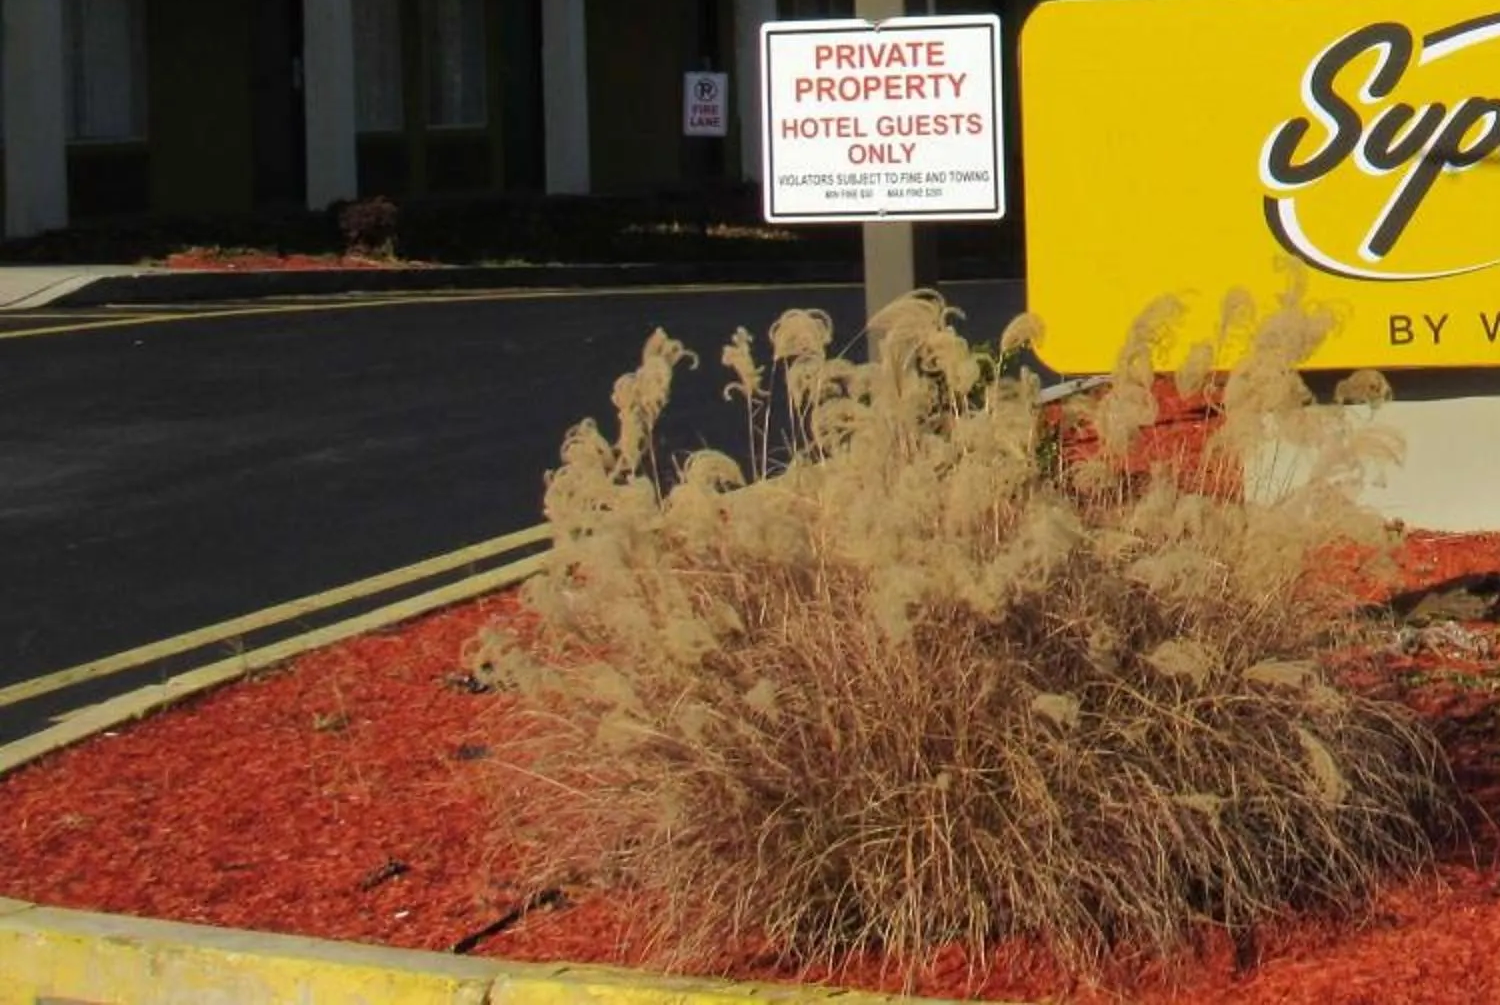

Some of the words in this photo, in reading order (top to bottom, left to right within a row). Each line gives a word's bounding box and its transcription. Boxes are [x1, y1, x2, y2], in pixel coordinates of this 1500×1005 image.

[815, 41, 945, 70] PRIVATE
[795, 72, 967, 102] PROPERTY
[690, 117, 721, 127] LANE
[781, 117, 868, 139] HOTEL
[876, 113, 983, 137] GUESTS
[847, 143, 916, 165] ONLY
[778, 173, 834, 186] VIOLATORS
[836, 172, 881, 185] SUBJECT
[884, 172, 898, 184] TO
[900, 172, 923, 184] FINE
[925, 171, 946, 183] AND
[949, 170, 990, 183] TOWING
[1389, 312, 1450, 346] BY
